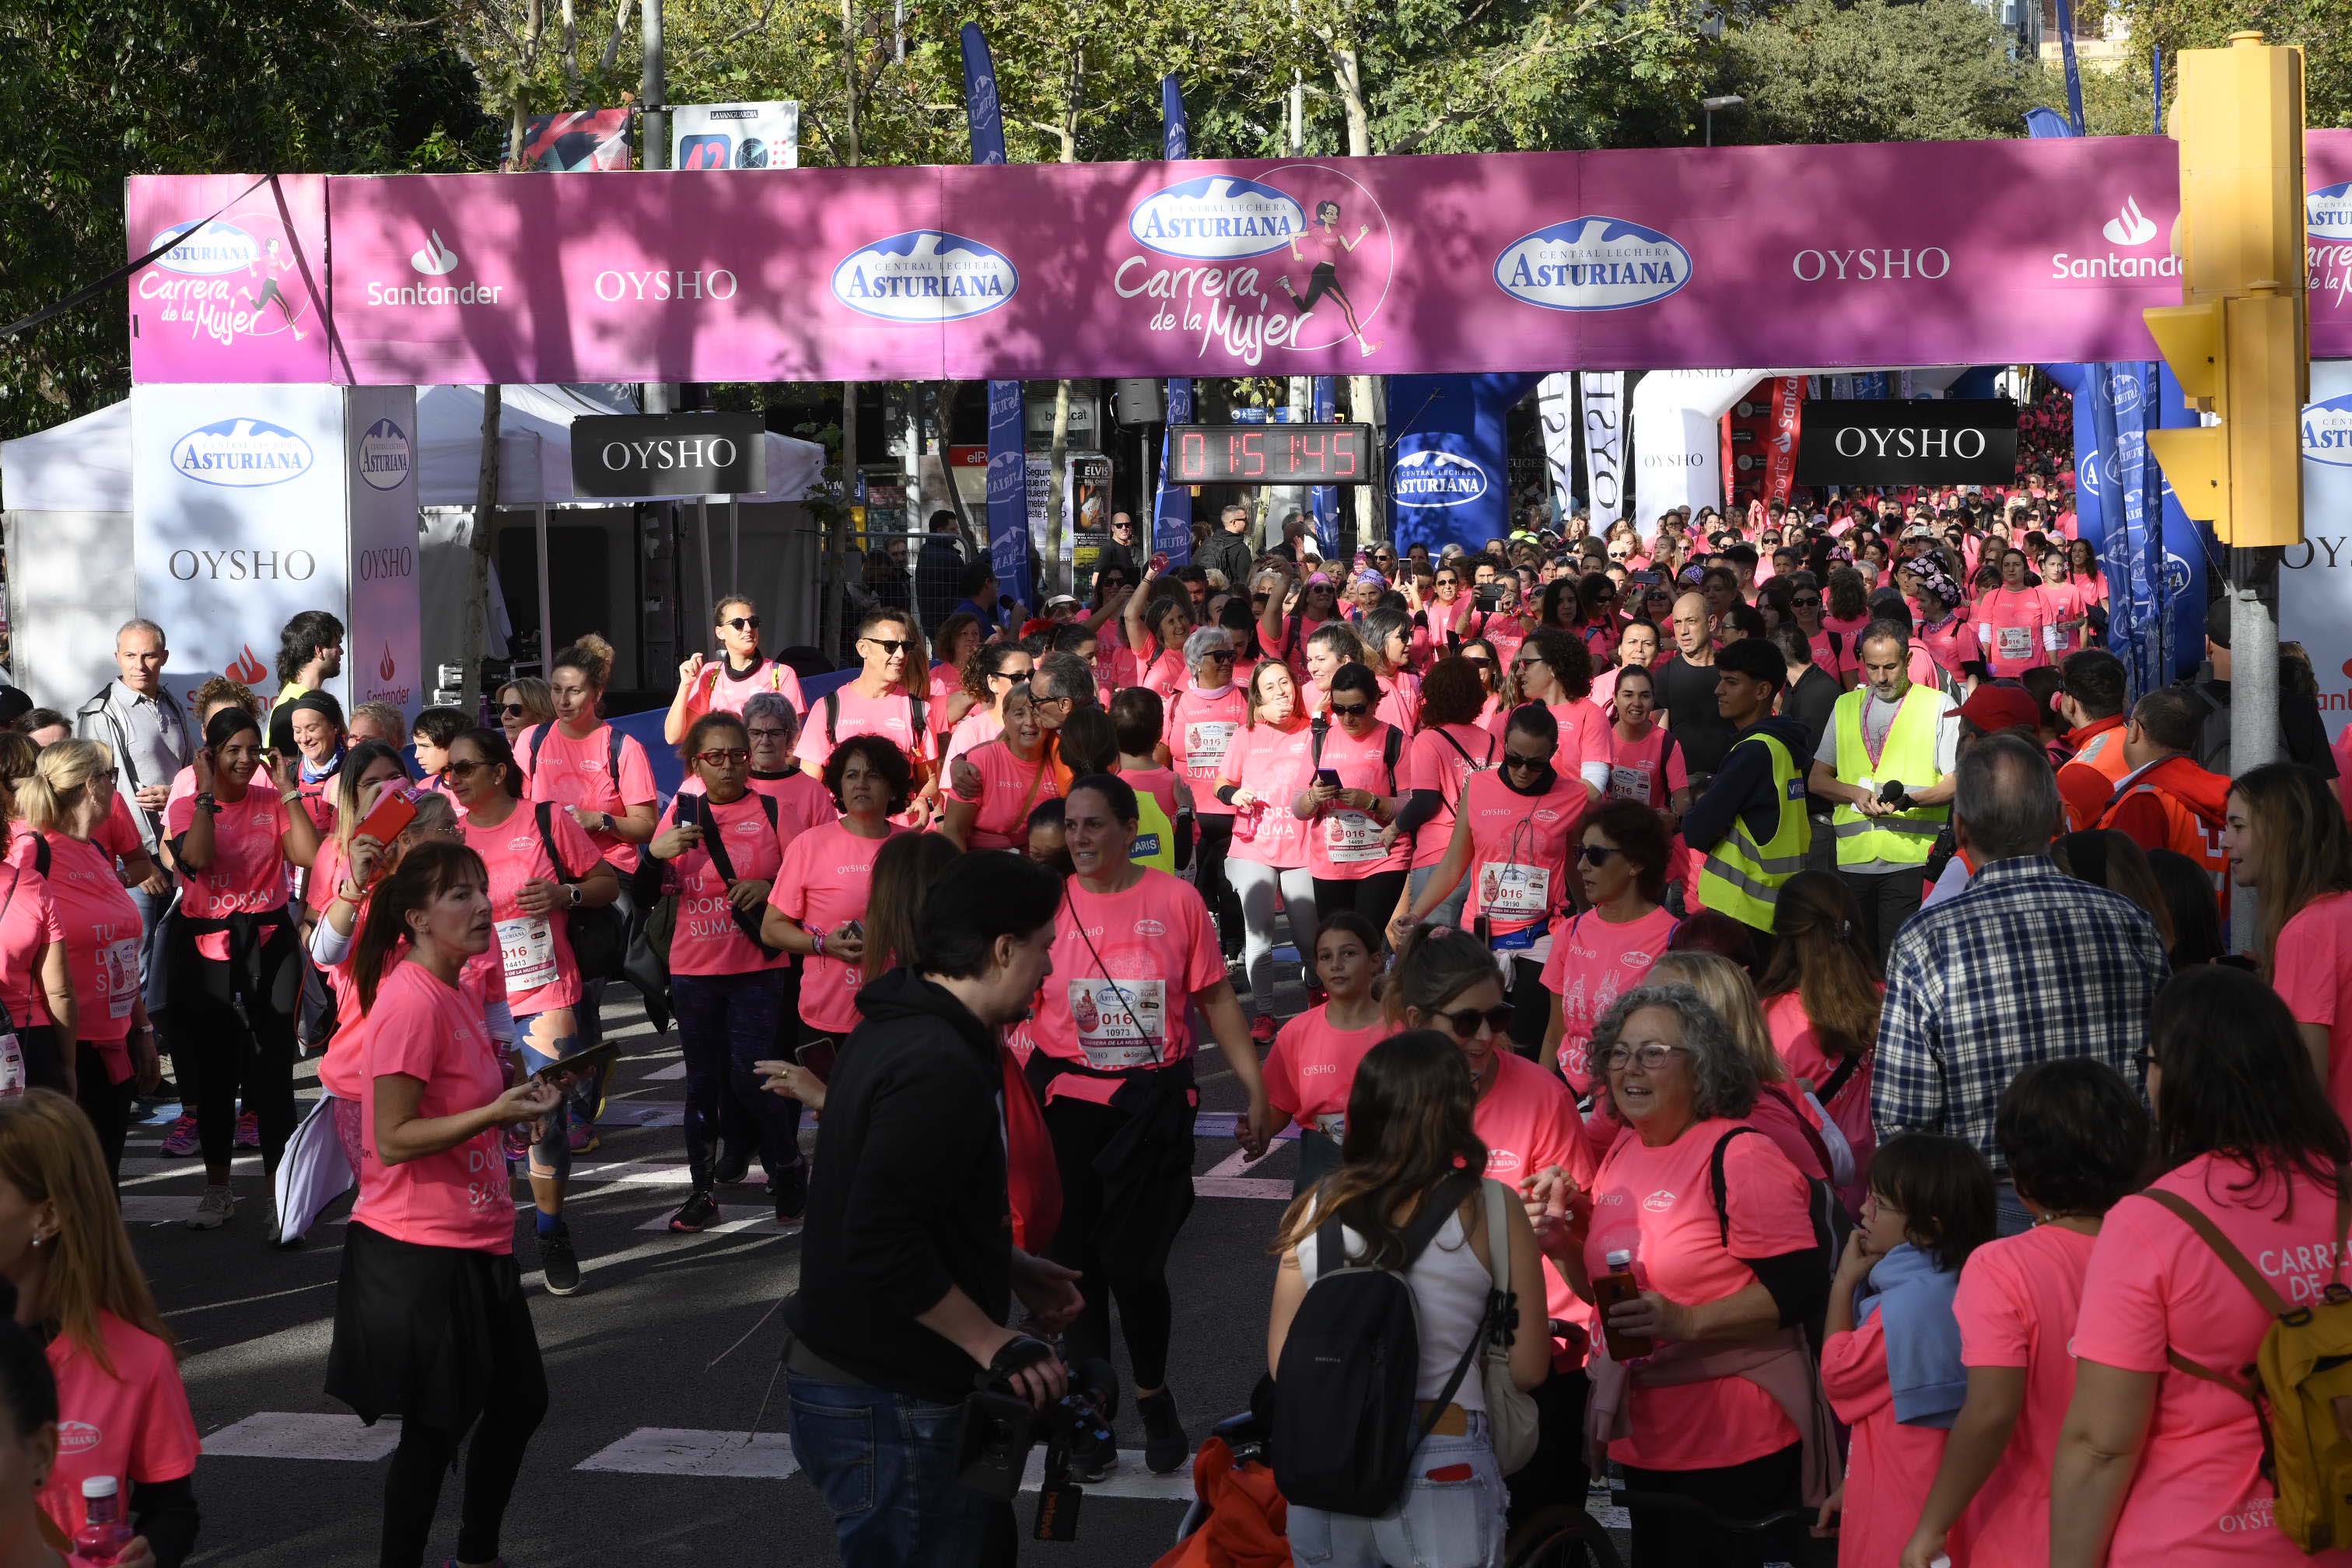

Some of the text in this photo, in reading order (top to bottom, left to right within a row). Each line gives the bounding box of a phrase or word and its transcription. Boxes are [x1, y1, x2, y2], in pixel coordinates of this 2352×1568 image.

[719, 110, 758, 119] VANGUARDIA
[1230, 203, 1288, 212] LECHERA
[1143, 206, 1292, 239] ASTURIANA
[1539, 247, 1670, 260] CENTRAL LECHERA
[875, 261, 999, 271] CENTRAL LECHERA
[1509, 253, 1677, 288] ASTURIANA
[1793, 247, 1951, 282] OYSHO
[2052, 252, 2182, 279] Santand
[139, 271, 229, 299] Carrera
[595, 269, 738, 302] OYSHO
[849, 265, 1005, 298] ASTURIANA
[1115, 255, 1259, 299] Carrera
[2325, 268, 2338, 290] la
[368, 280, 502, 306] Santander
[161, 297, 265, 345] de la Mujer
[1150, 295, 1314, 366] de la Mujer
[1836, 427, 1985, 459] OYSHO
[182, 443, 303, 470] ASTURIANA
[362, 446, 408, 473] ASTURIANA
[602, 438, 737, 471] OYSHO
[1645, 453, 1703, 467] OYSHO
[1085, 467, 1108, 475] ELVIS
[1027, 480, 1039, 489] que
[1391, 474, 1480, 495] ASTURIANA
[169, 549, 315, 580] OYSHO
[360, 546, 411, 581] OYSHO
[1187, 768, 1216, 779] SUM
[1614, 784, 1632, 794] 016
[837, 863, 871, 875] OYSHO
[1501, 888, 1522, 898] 016
[91, 924, 115, 942] TU
[690, 919, 741, 937] SUMA
[506, 959, 527, 968] 14413
[1102, 1013, 1133, 1024] 016
[1106, 1028, 1130, 1037] 10973
[1599, 1192, 1623, 1206] YSHO
